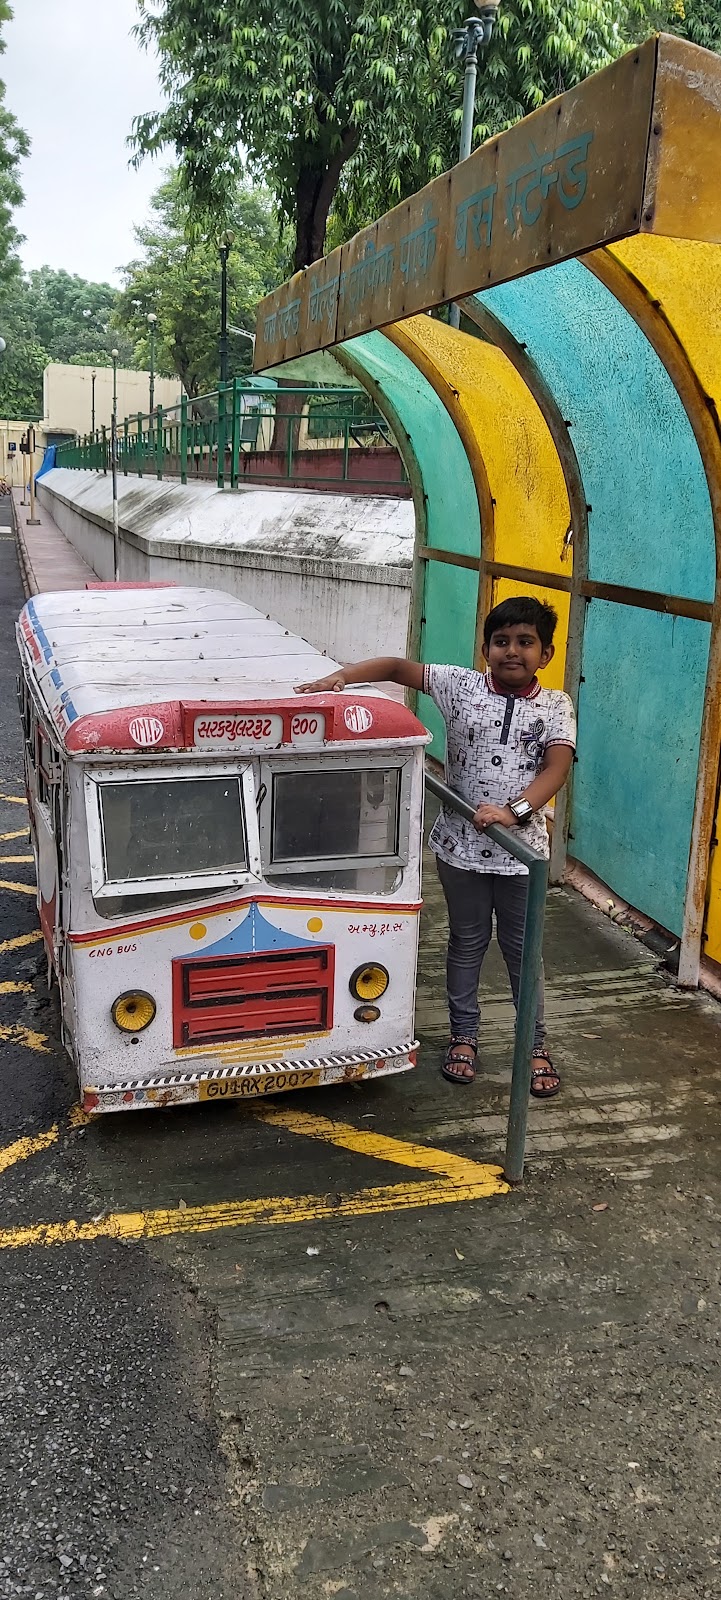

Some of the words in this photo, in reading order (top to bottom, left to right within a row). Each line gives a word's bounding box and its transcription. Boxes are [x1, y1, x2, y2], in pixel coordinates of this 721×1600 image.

[400, 200, 440, 284] पार्क
[454, 183, 498, 258] बस
[88, 947, 113, 958] CNG
[116, 943, 137, 954] BUS
